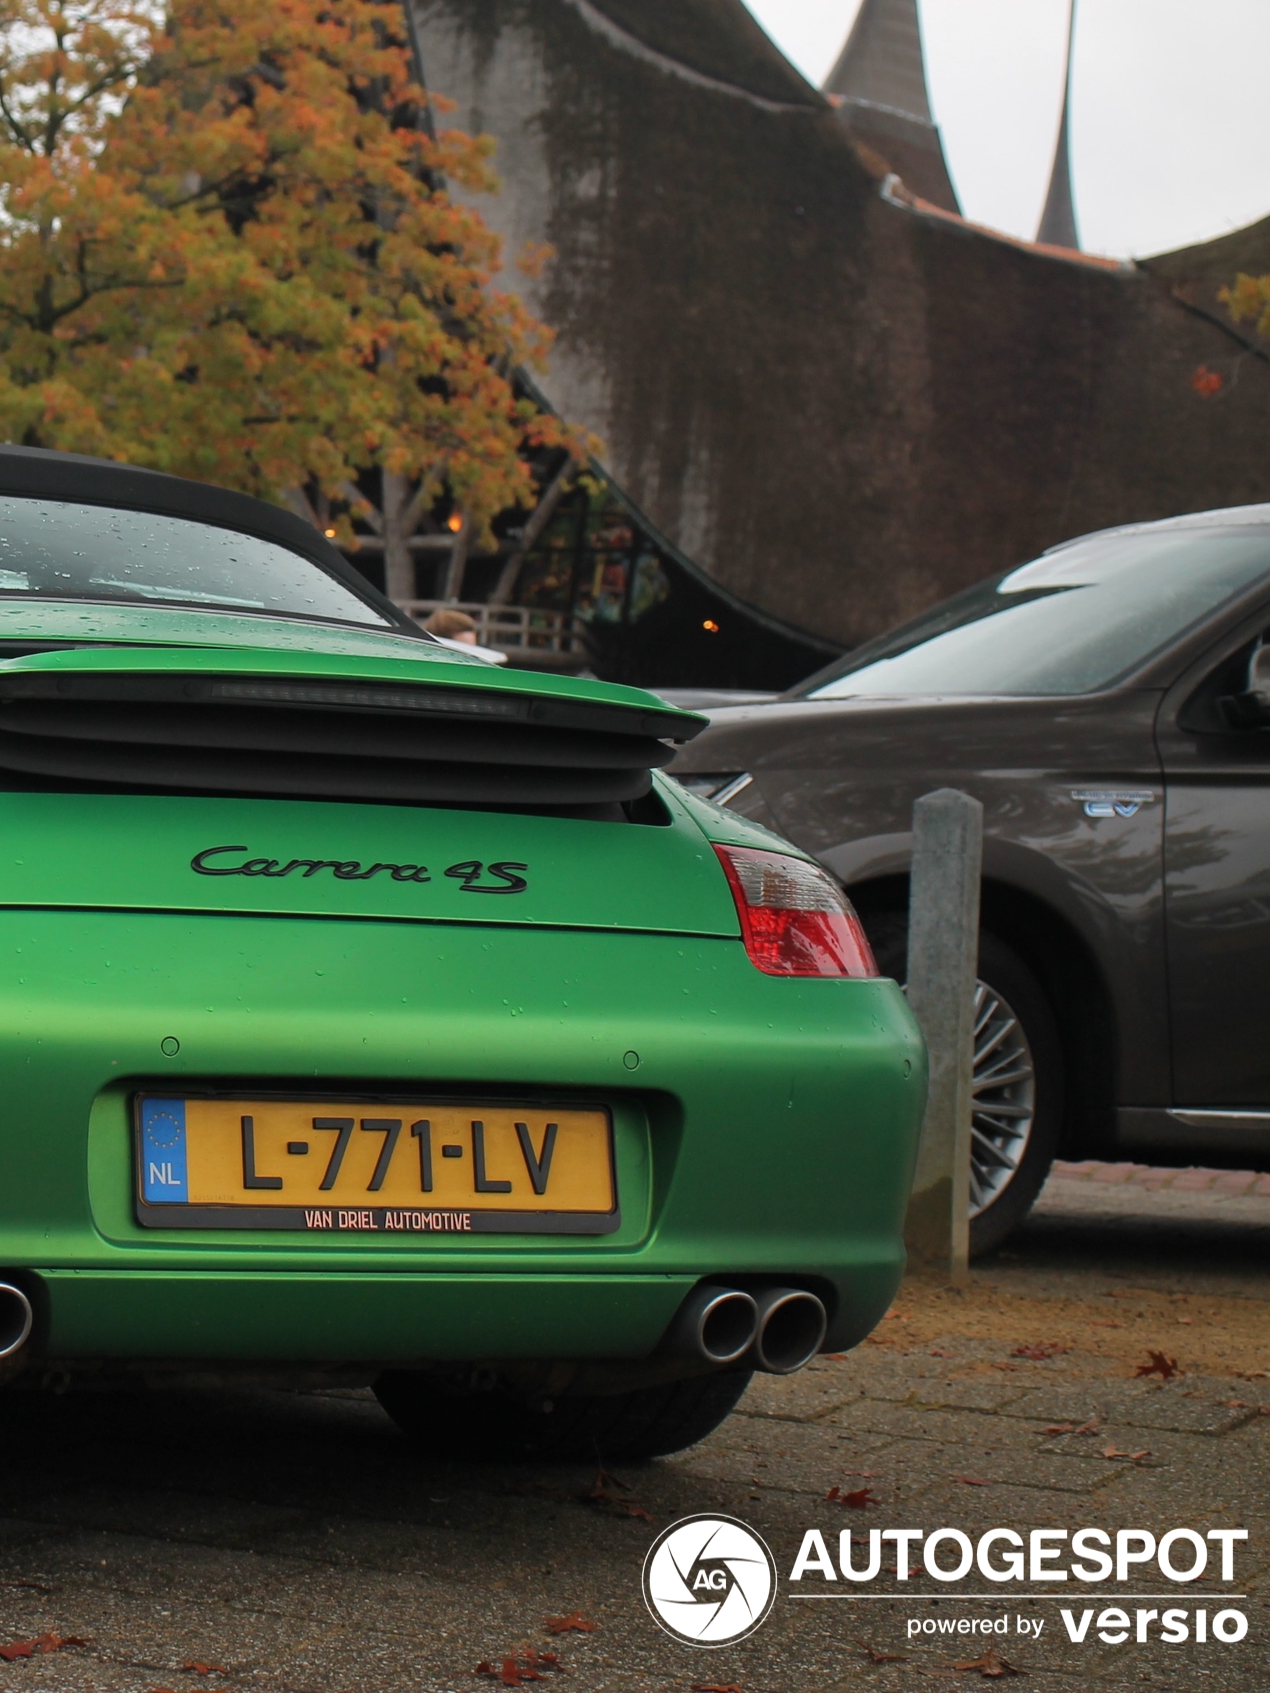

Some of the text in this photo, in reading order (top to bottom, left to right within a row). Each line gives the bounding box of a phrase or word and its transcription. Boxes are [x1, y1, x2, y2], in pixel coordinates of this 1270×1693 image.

[1083, 801, 1142, 818] EV
[190, 845, 529, 894] Carrera 4S
[241, 1115, 558, 1195] L-771-LV
[149, 1162, 181, 1185] NL
[304, 1210, 471, 1230] VAN DRIEL AUTOMOTIVE
